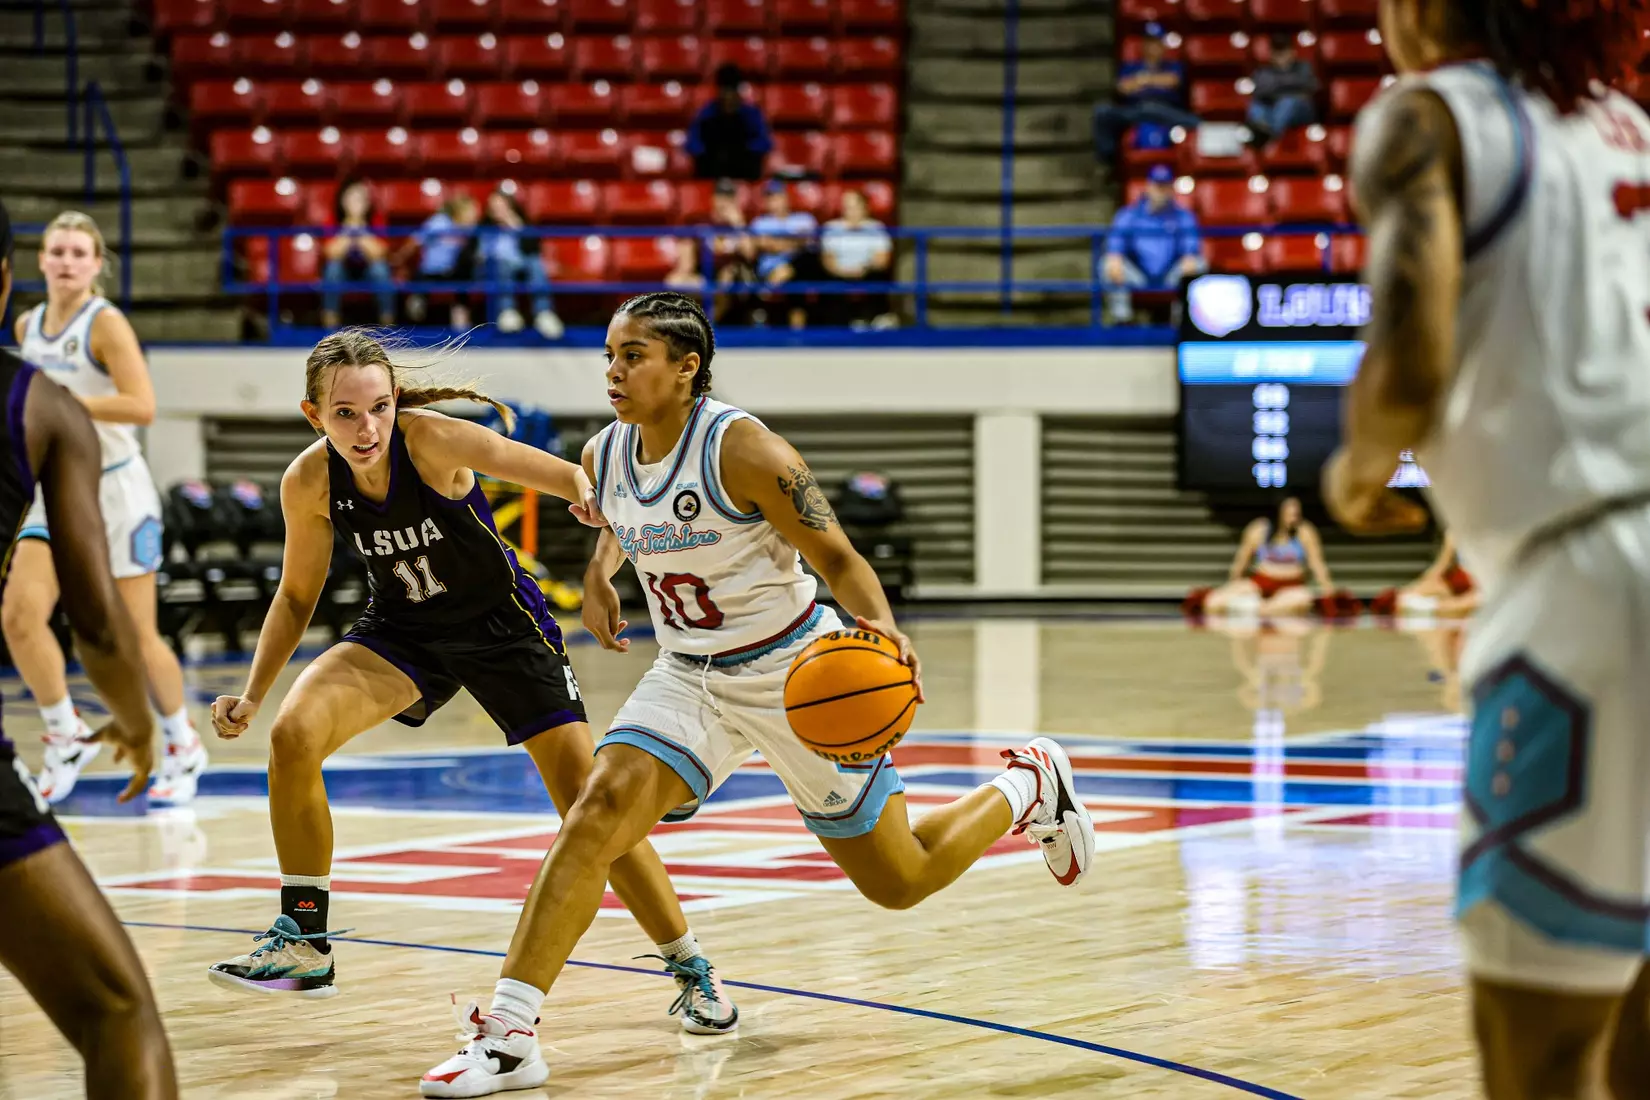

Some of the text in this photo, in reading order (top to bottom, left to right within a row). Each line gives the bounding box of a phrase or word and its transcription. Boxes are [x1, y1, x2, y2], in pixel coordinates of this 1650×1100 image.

[353, 517, 444, 556] LSUA
[640, 521, 721, 555] Techsters
[392, 555, 447, 603] 11
[644, 572, 725, 630] 10
[823, 798, 847, 807] adidas
